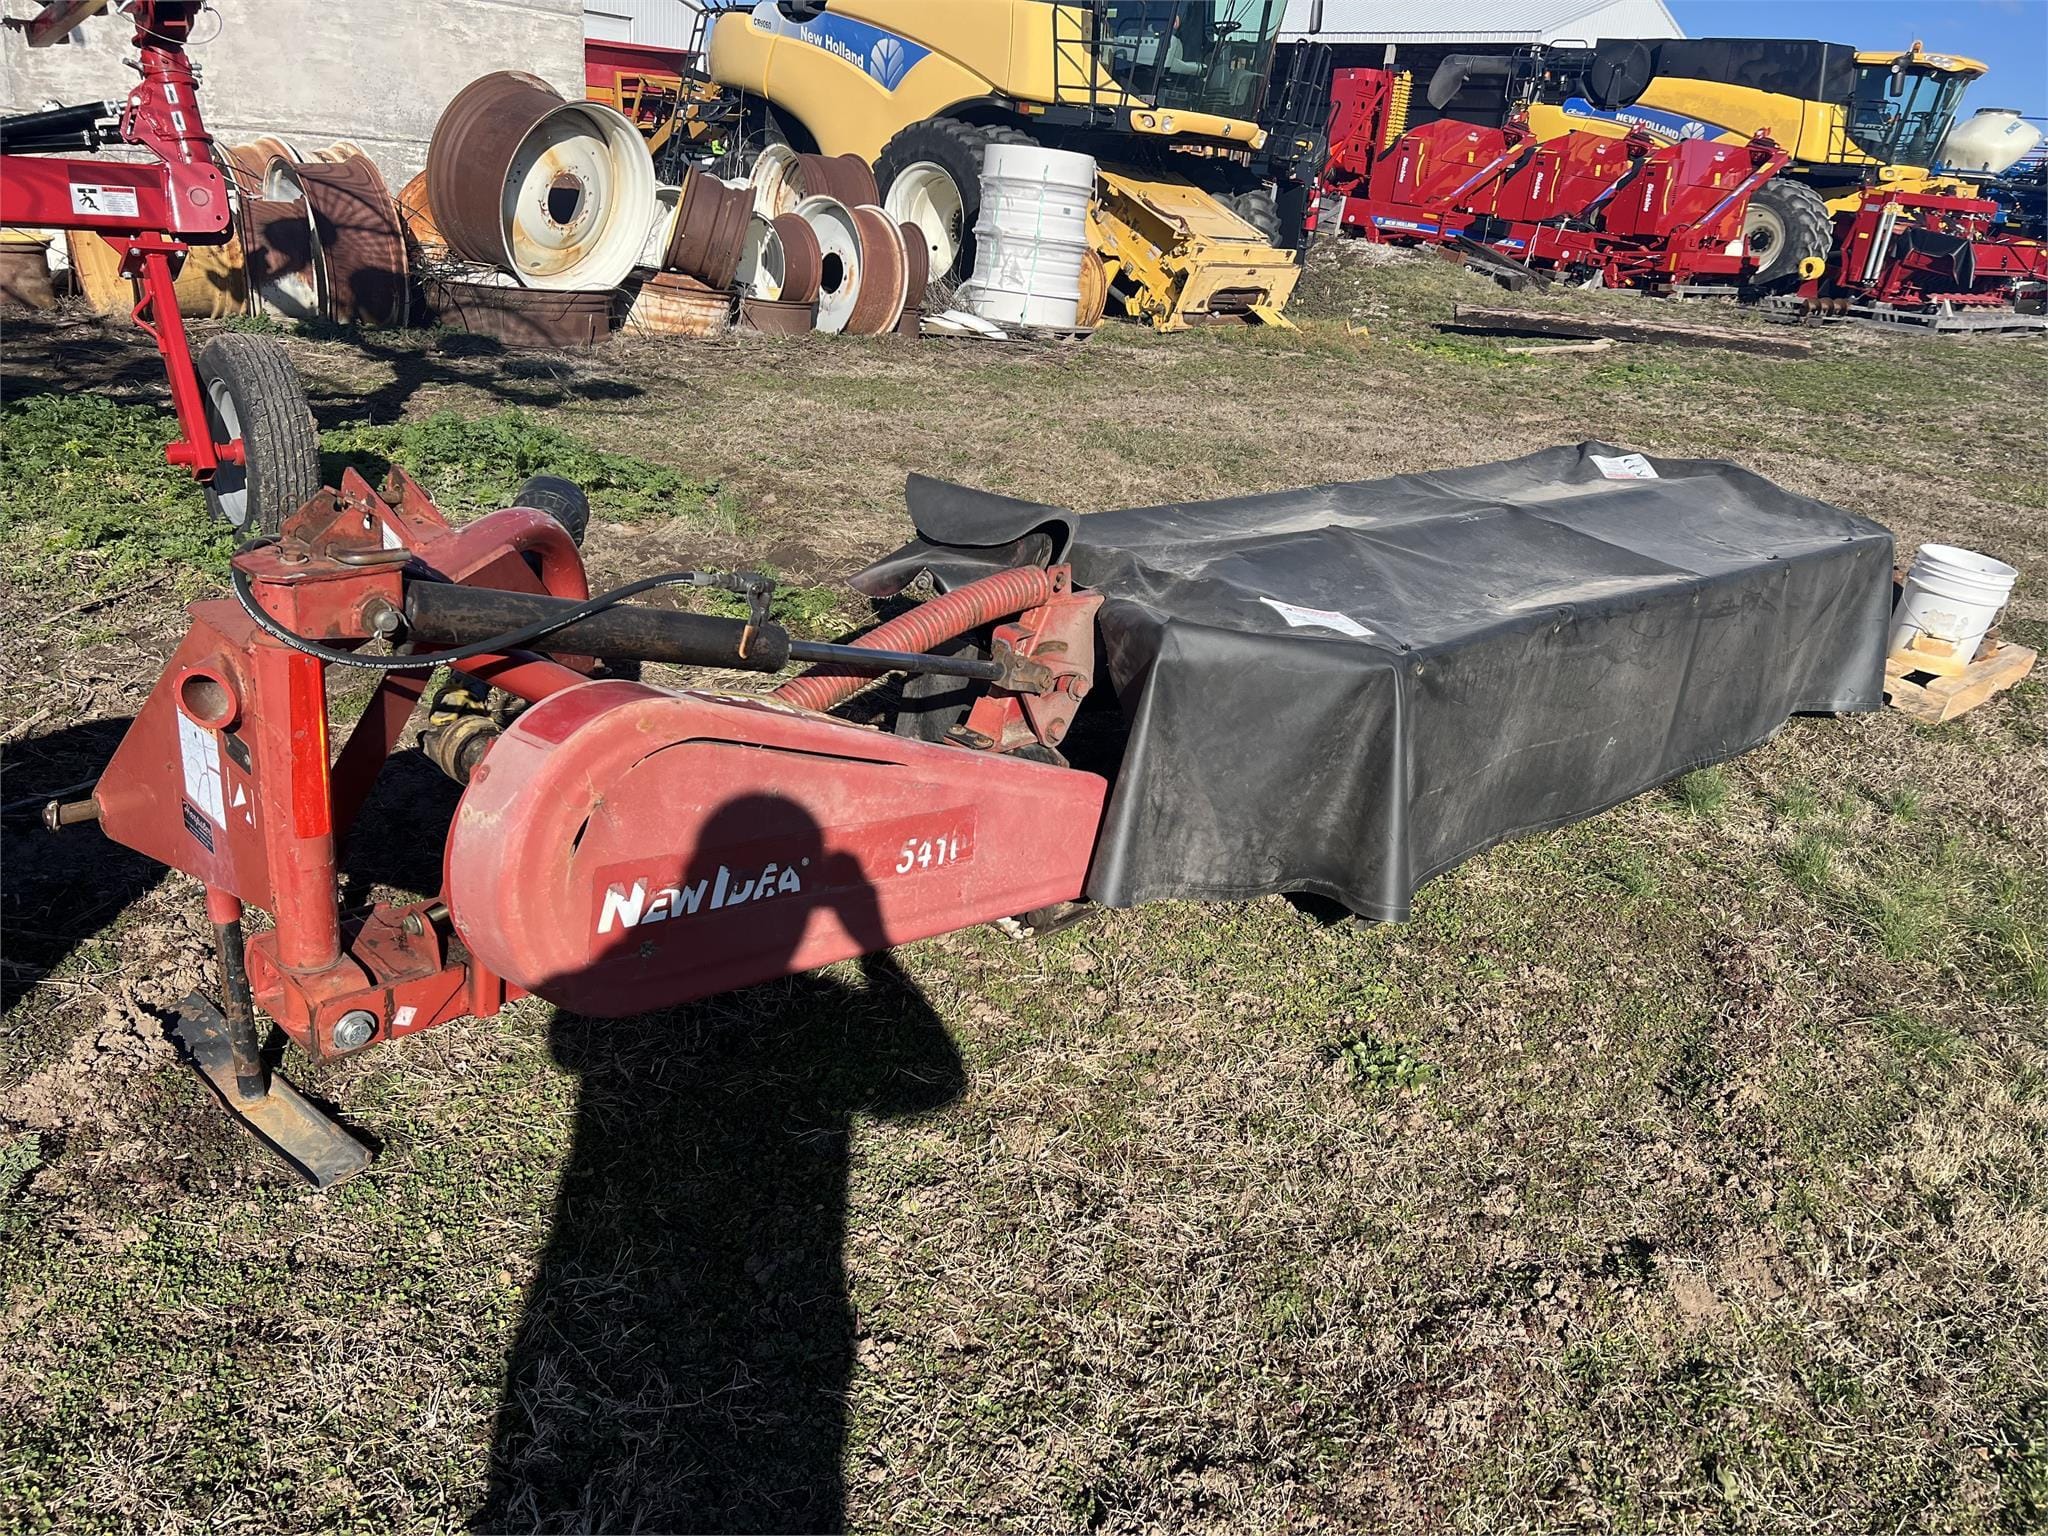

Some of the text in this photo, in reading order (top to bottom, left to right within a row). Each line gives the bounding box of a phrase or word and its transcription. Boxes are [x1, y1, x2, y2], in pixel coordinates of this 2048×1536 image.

[800, 26, 864, 69] New Holland
[1615, 112, 1638, 125] NEW
